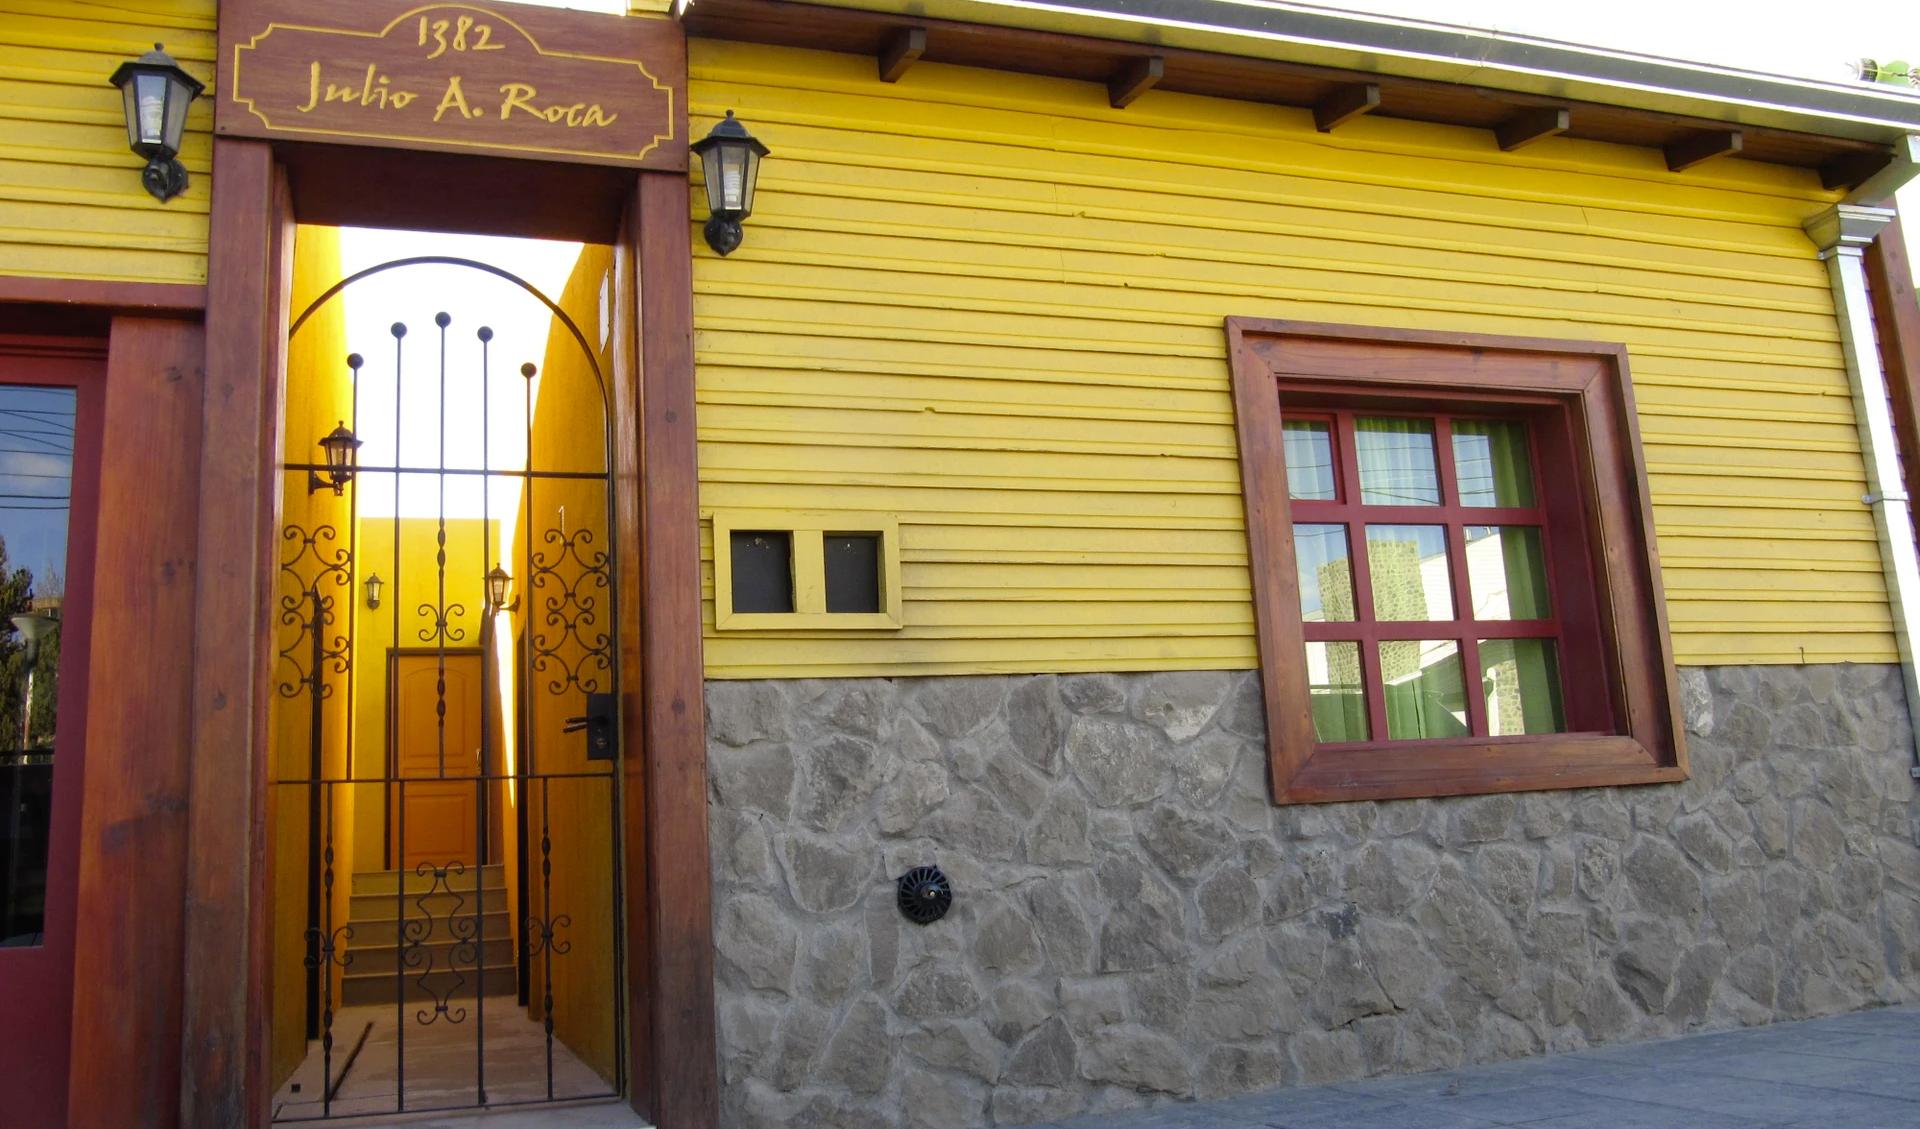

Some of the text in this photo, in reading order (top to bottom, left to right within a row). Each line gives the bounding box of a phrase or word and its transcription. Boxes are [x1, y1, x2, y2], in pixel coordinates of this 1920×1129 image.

[418, 15, 505, 60] 1382
[297, 61, 618, 128] Julio A. Roca
